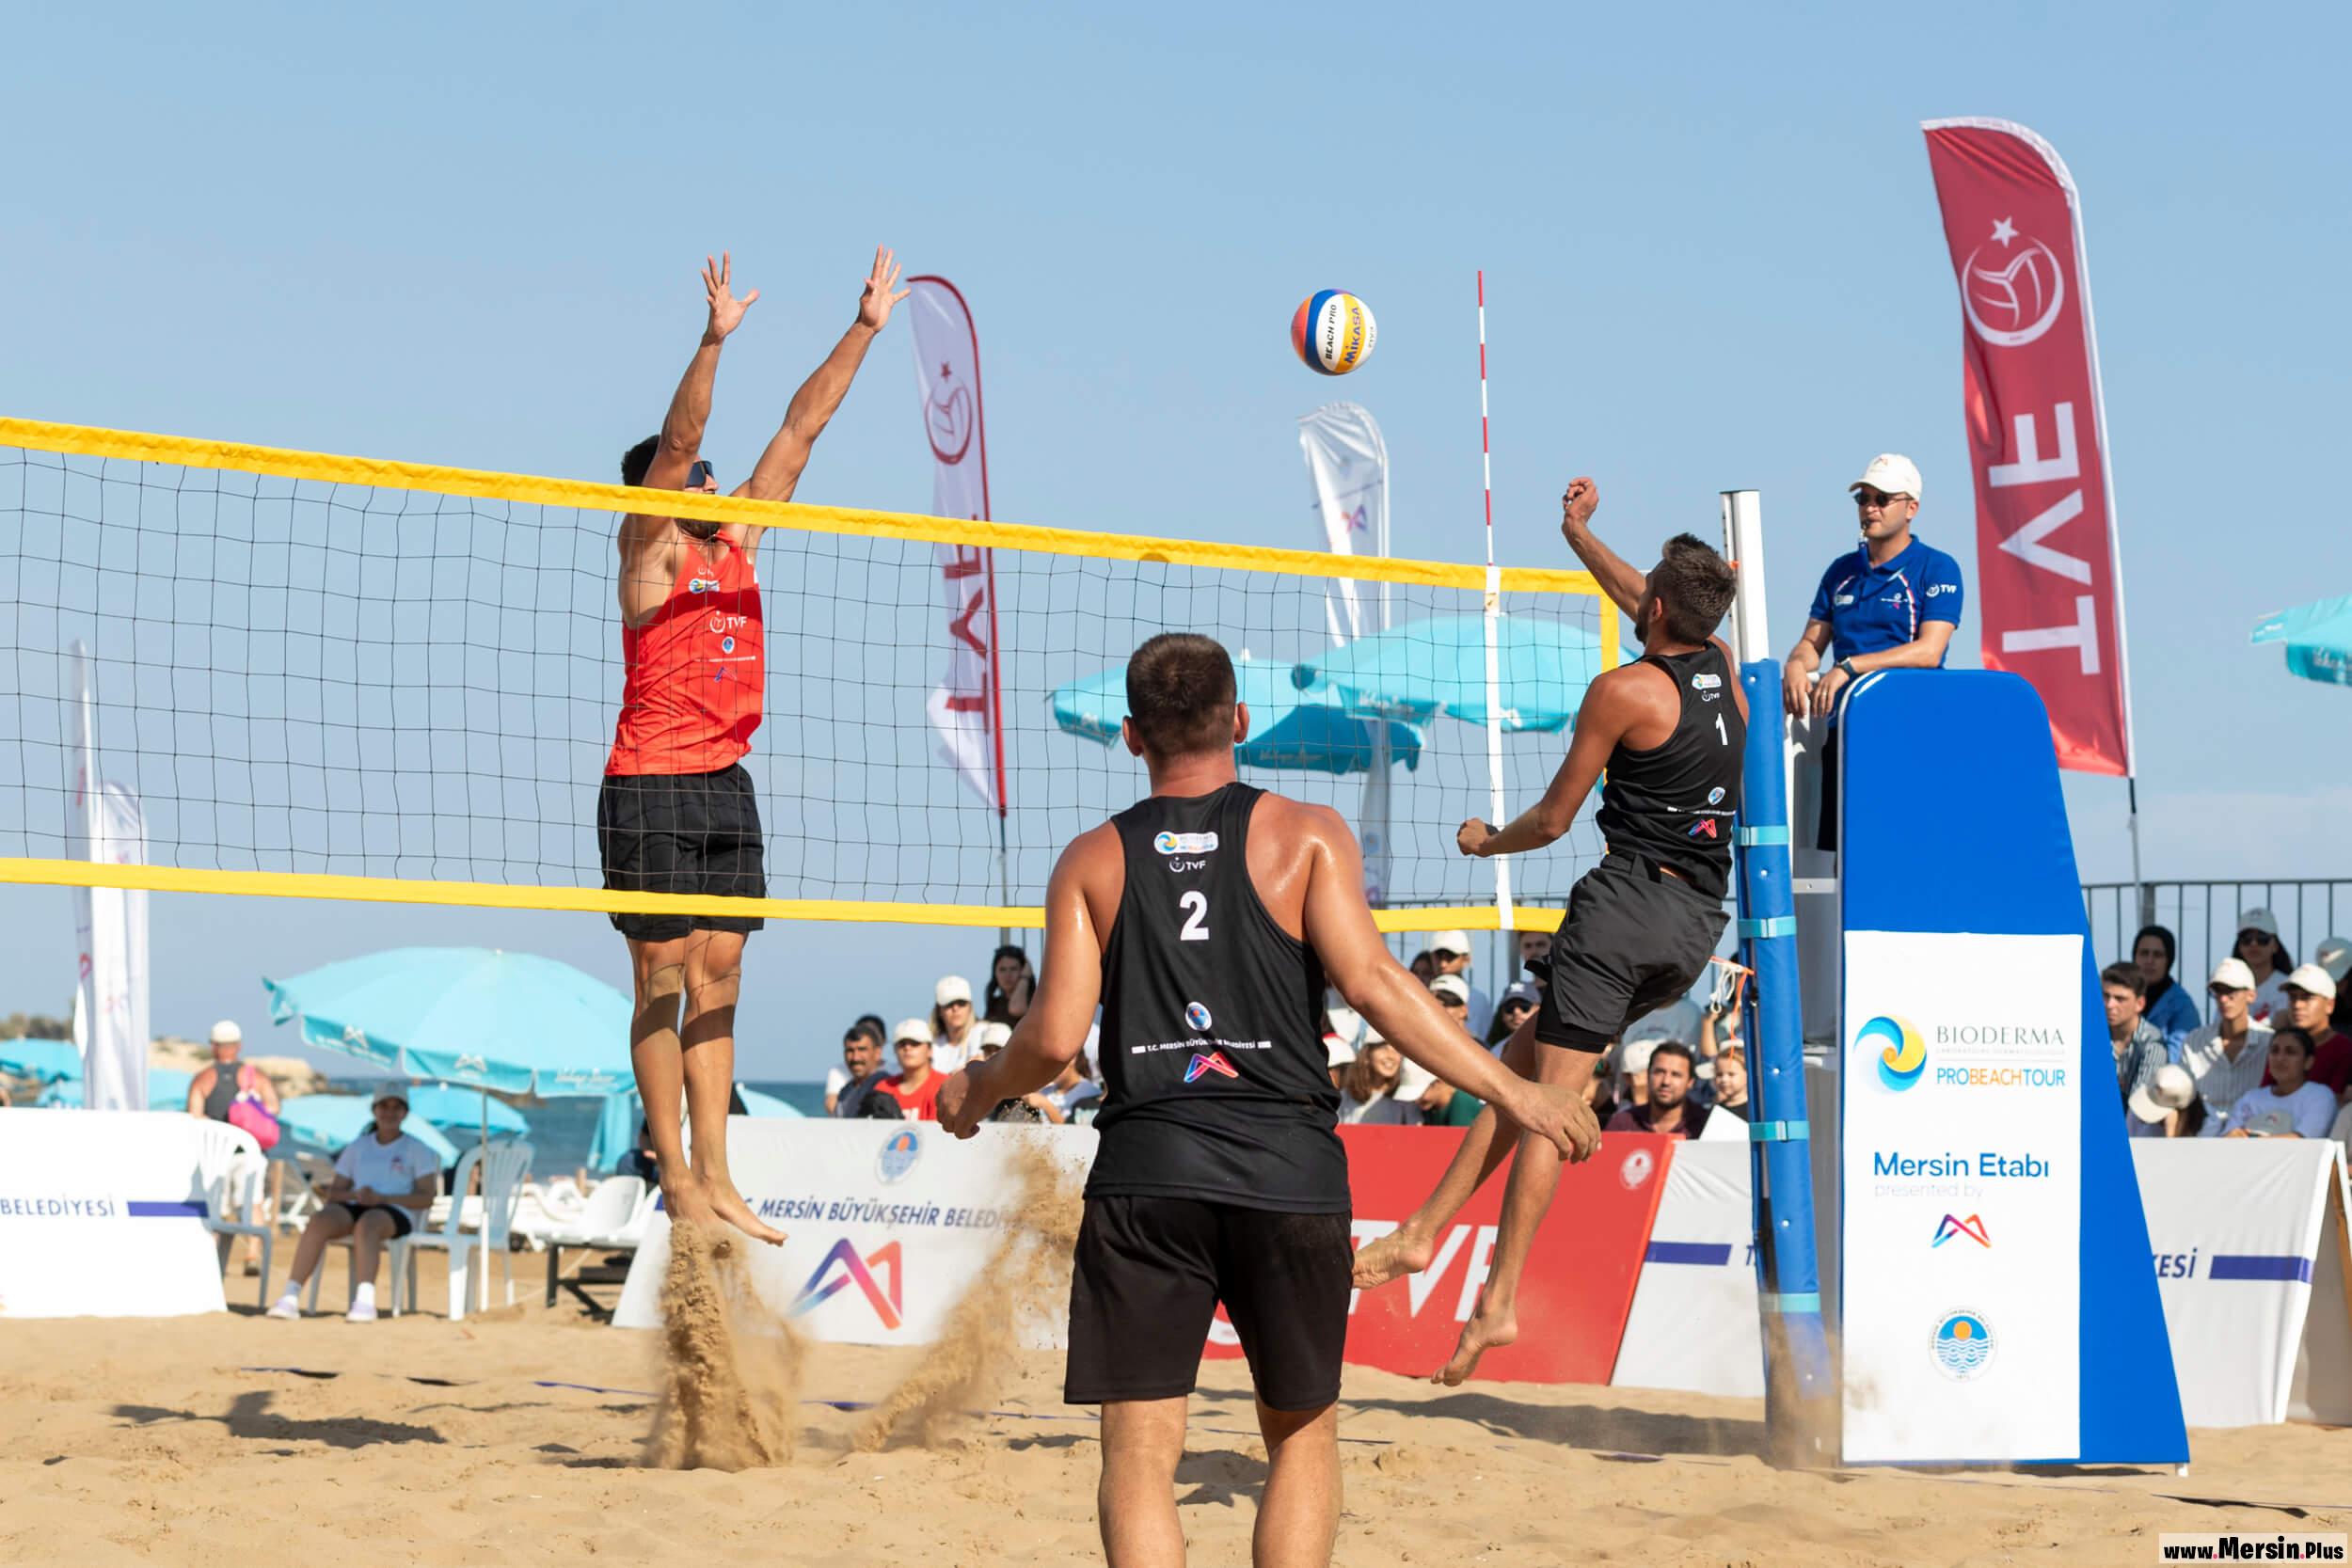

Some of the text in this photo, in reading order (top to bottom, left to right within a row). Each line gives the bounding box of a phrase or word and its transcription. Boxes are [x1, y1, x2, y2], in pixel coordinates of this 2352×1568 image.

[1325, 304, 1337, 360] BEACH PRO
[726, 616, 748, 629] TVF
[1715, 712, 1728, 746] 1
[1185, 860, 1206, 871] TVF
[1179, 890, 1210, 941] 2
[1936, 1025, 2065, 1045] BIODERMA
[1936, 1068, 2066, 1086] PROBEACHTOUR
[1874, 1152, 2049, 1177] Mersin Etabı
[1874, 1183, 1983, 1198] presented by
[0, 1193, 115, 1215] BELEDİYESİ
[758, 1196, 825, 1220] MERSİN
[828, 1196, 940, 1229] BÜYÜKŞEHİR
[2153, 1246, 2198, 1278] ESİ
